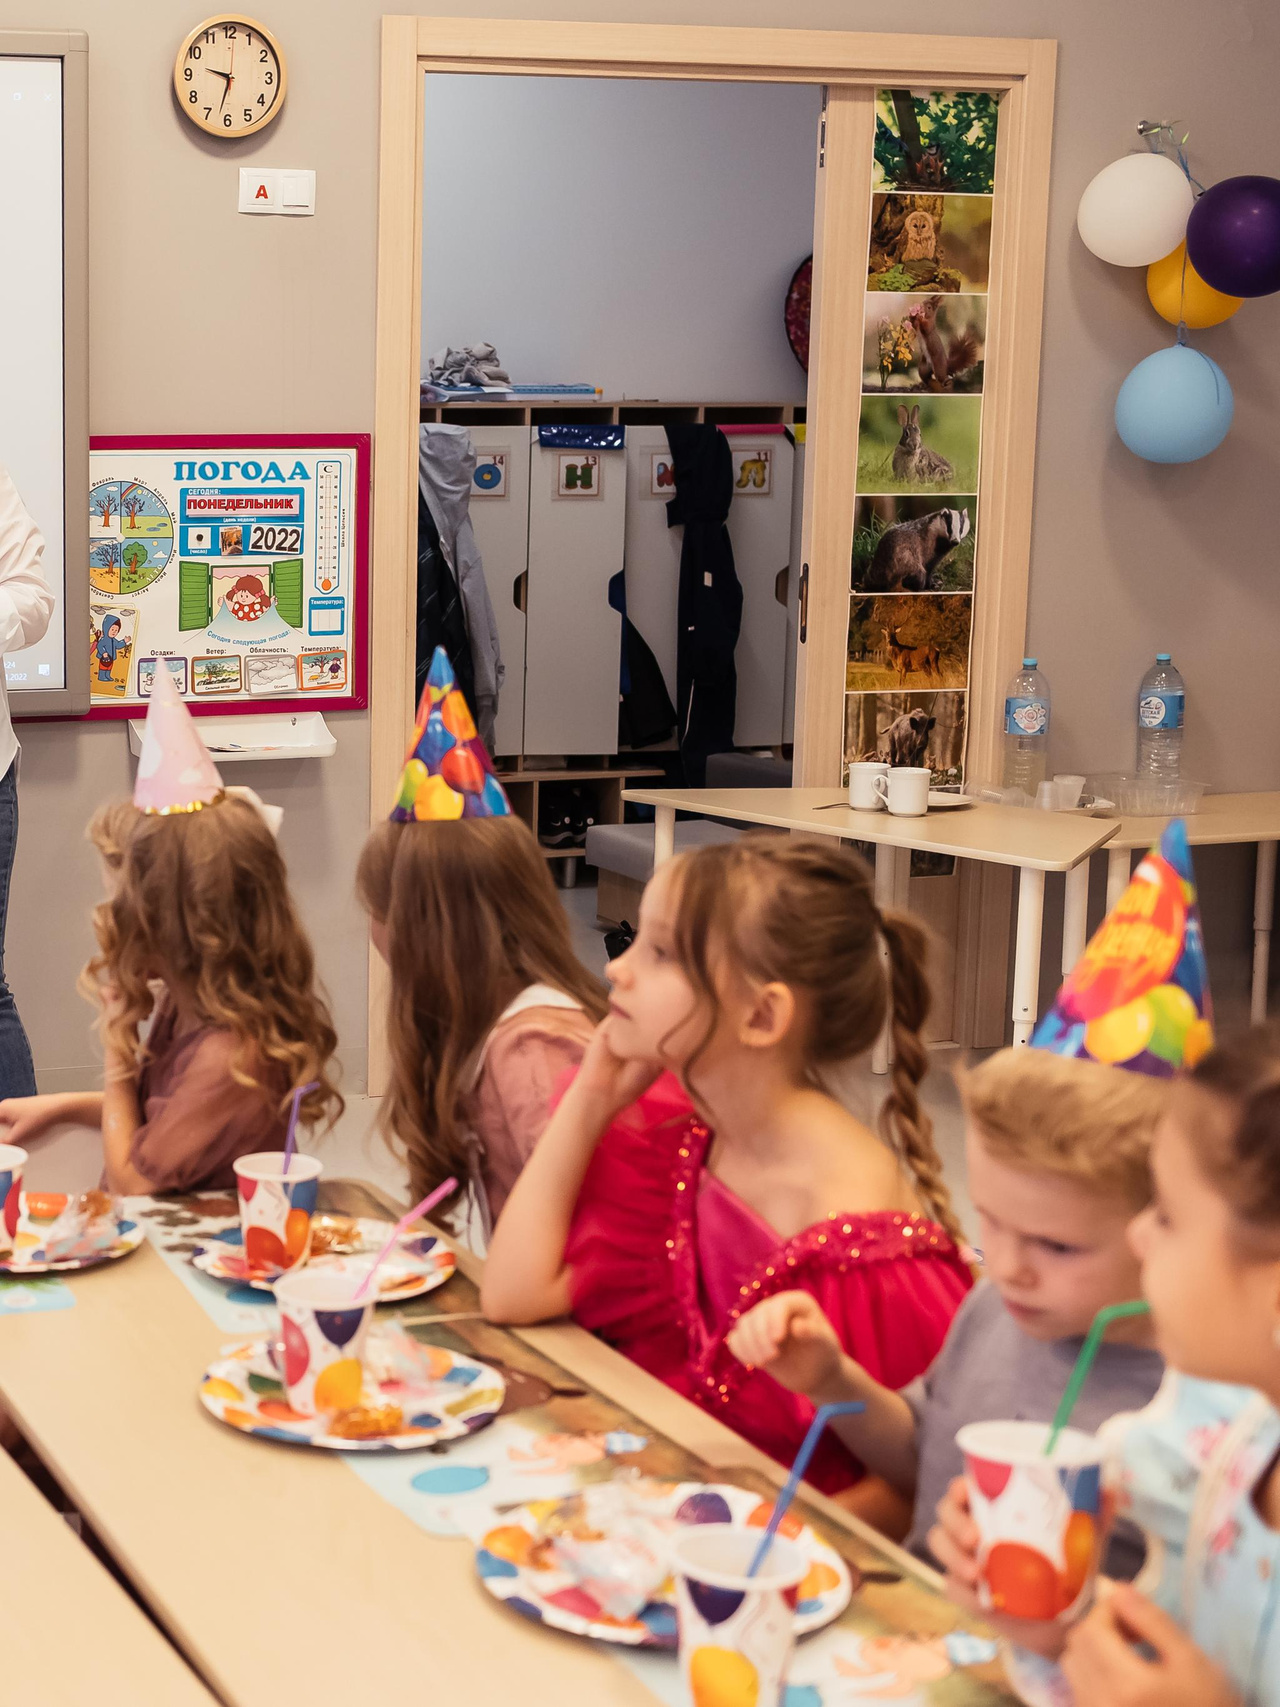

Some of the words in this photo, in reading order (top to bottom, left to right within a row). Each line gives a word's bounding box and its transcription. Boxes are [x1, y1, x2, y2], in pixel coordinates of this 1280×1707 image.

[204, 31, 215, 44] 11
[222, 26, 236, 39] 12
[246, 33, 251, 45] 1
[189, 46, 201, 59] 10
[260, 50, 268, 62] 2
[184, 68, 192, 80] 9
[265, 72, 273, 84] 3
[189, 91, 197, 103] 8
[257, 94, 265, 106] 4
[204, 108, 212, 120] 7
[244, 109, 252, 122] 5
[224, 114, 232, 127] 6
[492, 456, 504, 465] 14
[584, 456, 597, 466] 13
[757, 452, 768, 462] 11
[174, 461, 311, 483] ПОГОДА
[133, 477, 148, 486] Март
[187, 499, 294, 511] ПОНЕДЕЛЬНИК
[251, 526, 300, 552] 2022
[207, 630, 230, 643] Сегодня
[233, 638, 266, 647] следующая
[268, 629, 291, 643] погода:
